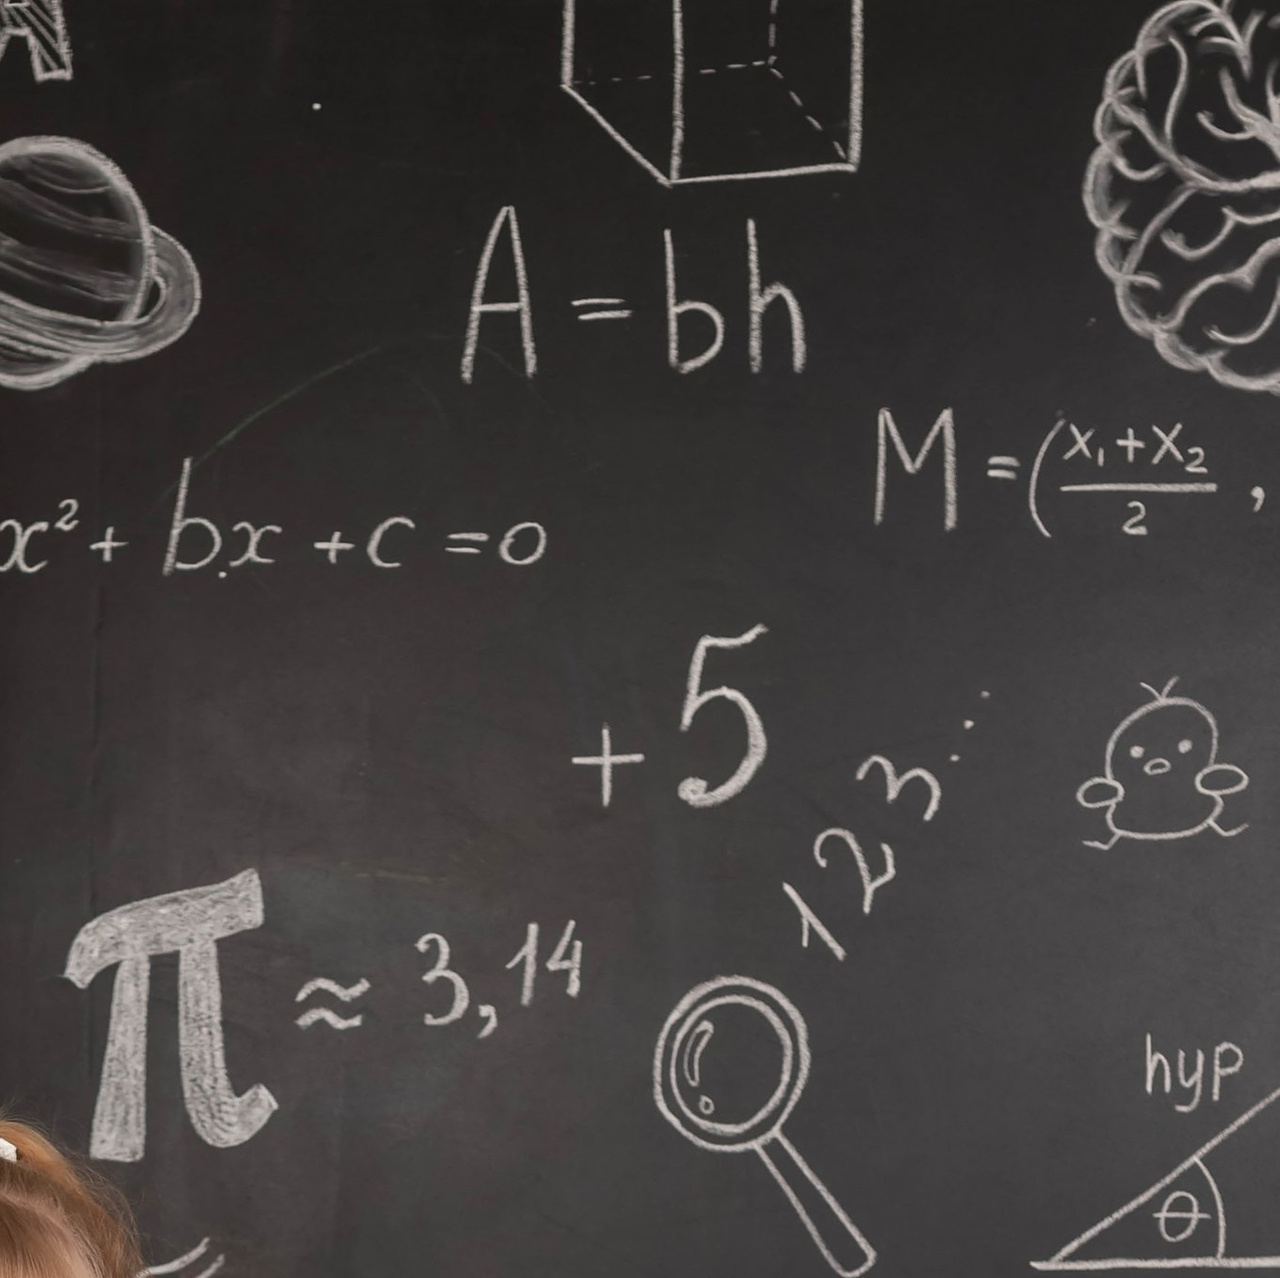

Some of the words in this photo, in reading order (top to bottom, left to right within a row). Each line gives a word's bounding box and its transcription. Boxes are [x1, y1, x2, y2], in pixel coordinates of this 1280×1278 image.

[461, 205, 537, 383] A
[664, 219, 806, 374] bh
[875, 408, 957, 530] M
[65, 868, 278, 1162] π
[415, 920, 582, 1038] 3,14
[1146, 1033, 1244, 1112] hyp
